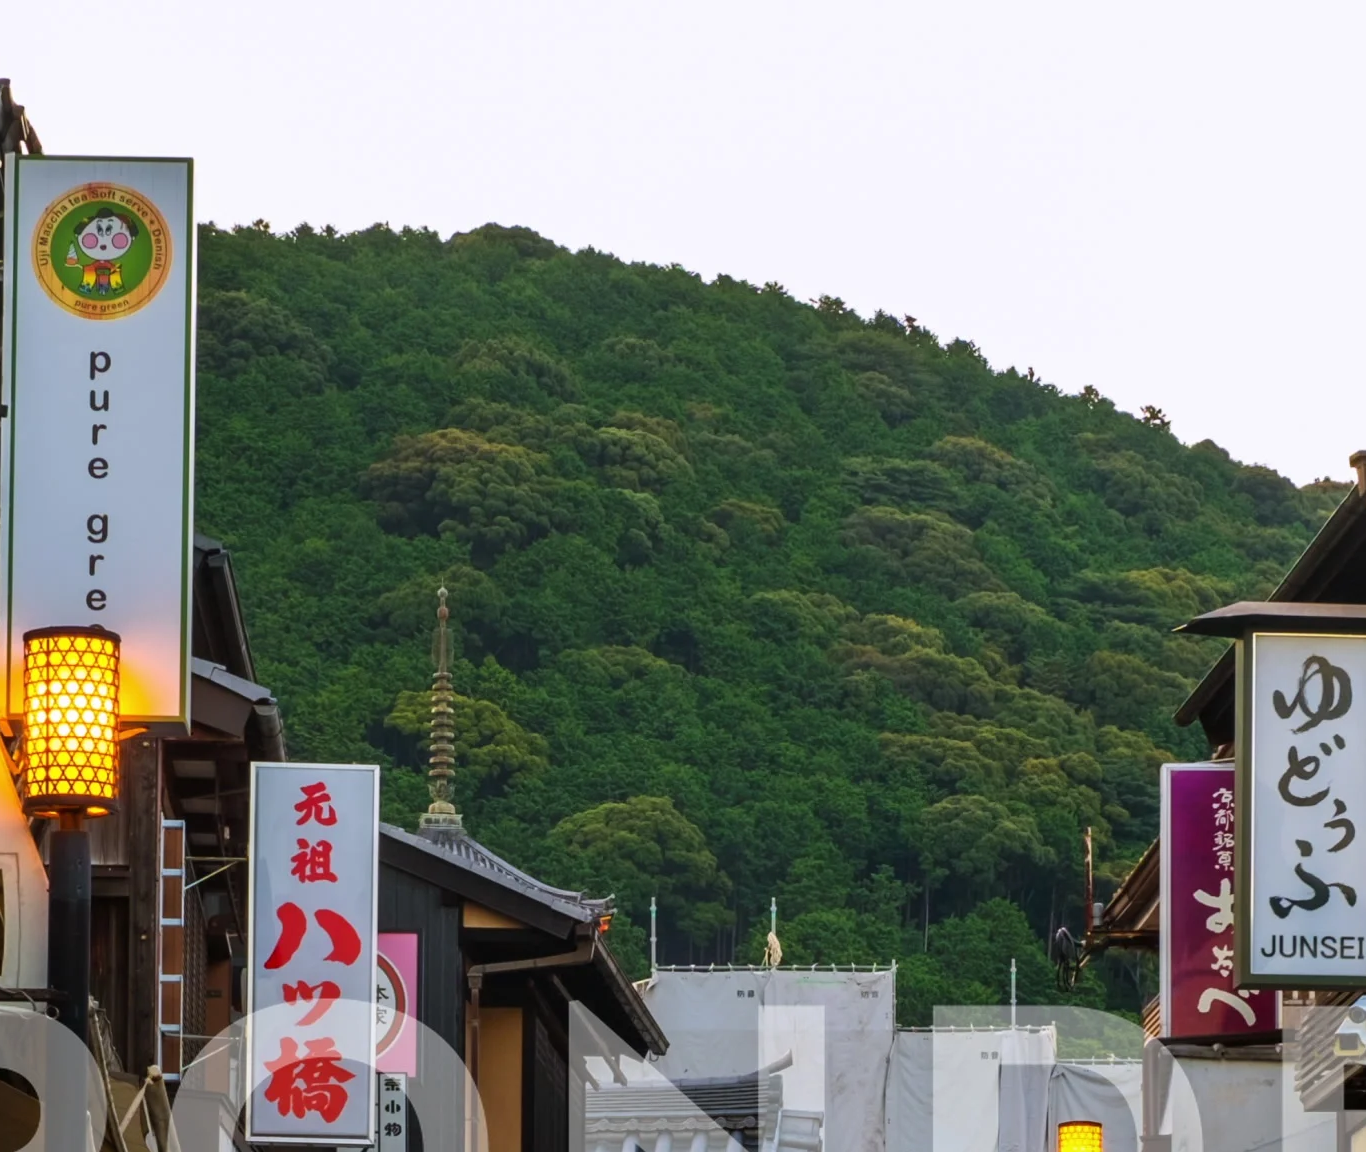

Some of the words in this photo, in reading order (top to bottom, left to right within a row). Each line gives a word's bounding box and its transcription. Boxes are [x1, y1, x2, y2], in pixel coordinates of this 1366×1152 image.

[91, 190, 116, 200] Soft
[119, 194, 149, 218] serve
[75, 299, 97, 311] pure
[100, 299, 129, 313] green
[88, 349, 112, 480] pure
[86, 513, 110, 629] gre
[1269, 654, 1358, 920] ゆどうふ
[1261, 934, 1366, 960] JUNSEI
